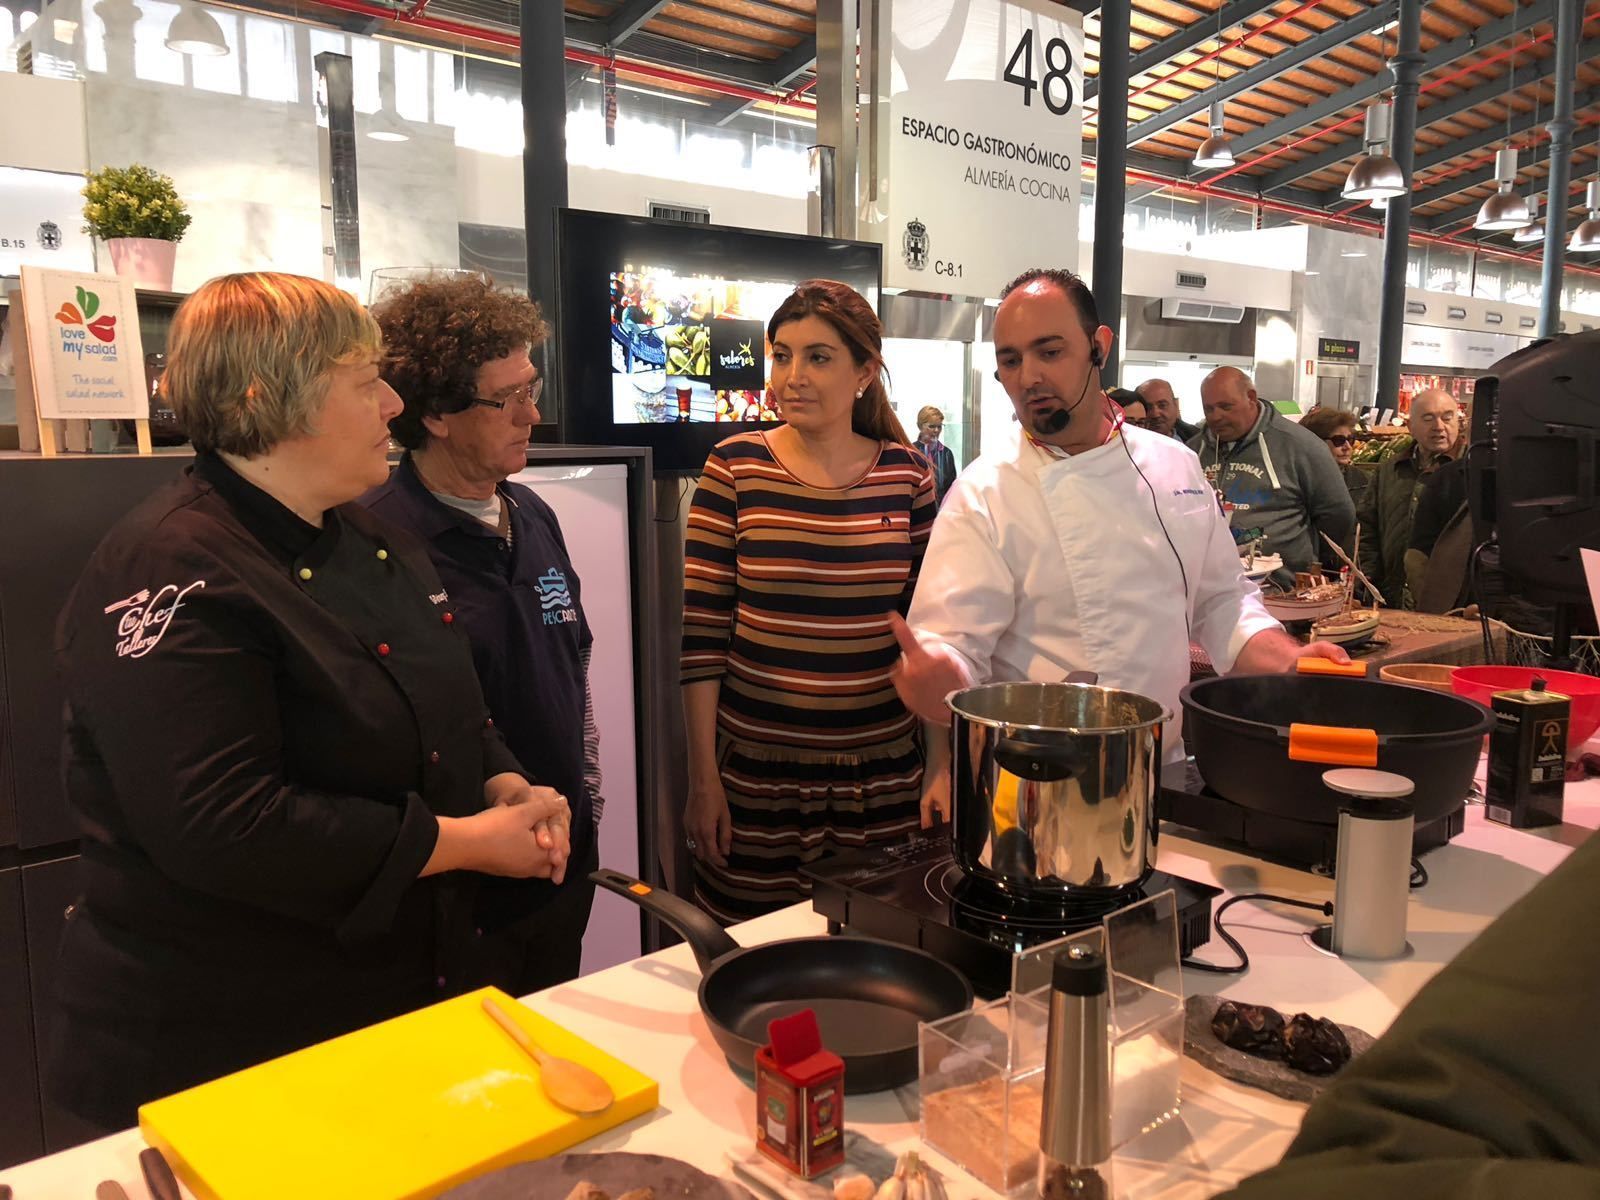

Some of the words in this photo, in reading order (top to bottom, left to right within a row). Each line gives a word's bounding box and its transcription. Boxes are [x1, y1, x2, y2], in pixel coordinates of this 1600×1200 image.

[1003, 28, 1073, 116] 48
[902, 116, 959, 146] ESPACIO
[963, 132, 1071, 171] GASTRONÓMICO
[964, 165, 1016, 192] ALMERÍA
[1019, 177, 1071, 203] COCINA
[1, 238, 26, 249] B.15
[935, 260, 962, 278] C-8.1
[60, 327, 85, 340] love
[63, 341, 83, 361] my
[85, 344, 117, 355] salad
[72, 374, 90, 385] The
[118, 580, 206, 659] Chef
